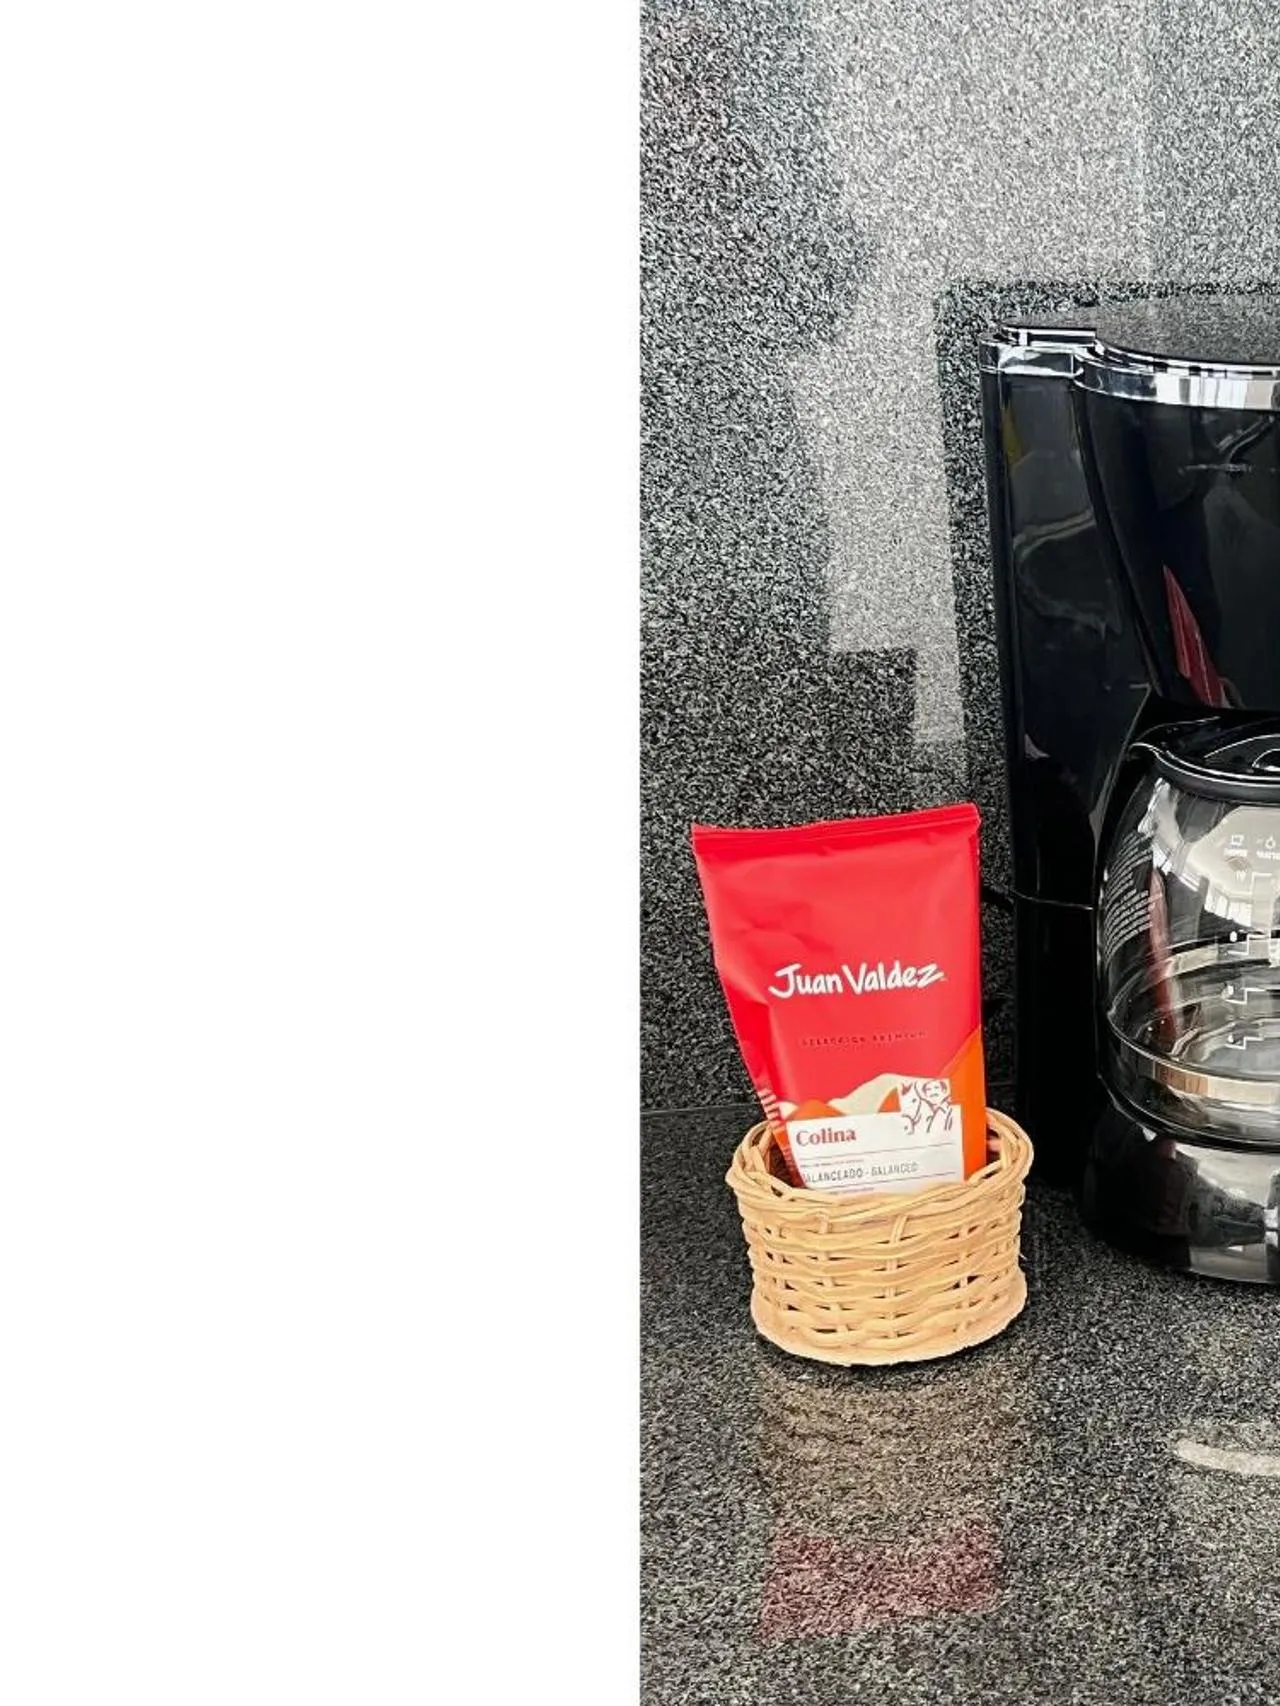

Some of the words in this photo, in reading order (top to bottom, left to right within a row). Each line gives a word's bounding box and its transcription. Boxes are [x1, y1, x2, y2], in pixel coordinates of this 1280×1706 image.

[768, 963, 844, 999] Juan
[841, 960, 945, 996] Valdez
[796, 1127, 857, 1147] Colina
